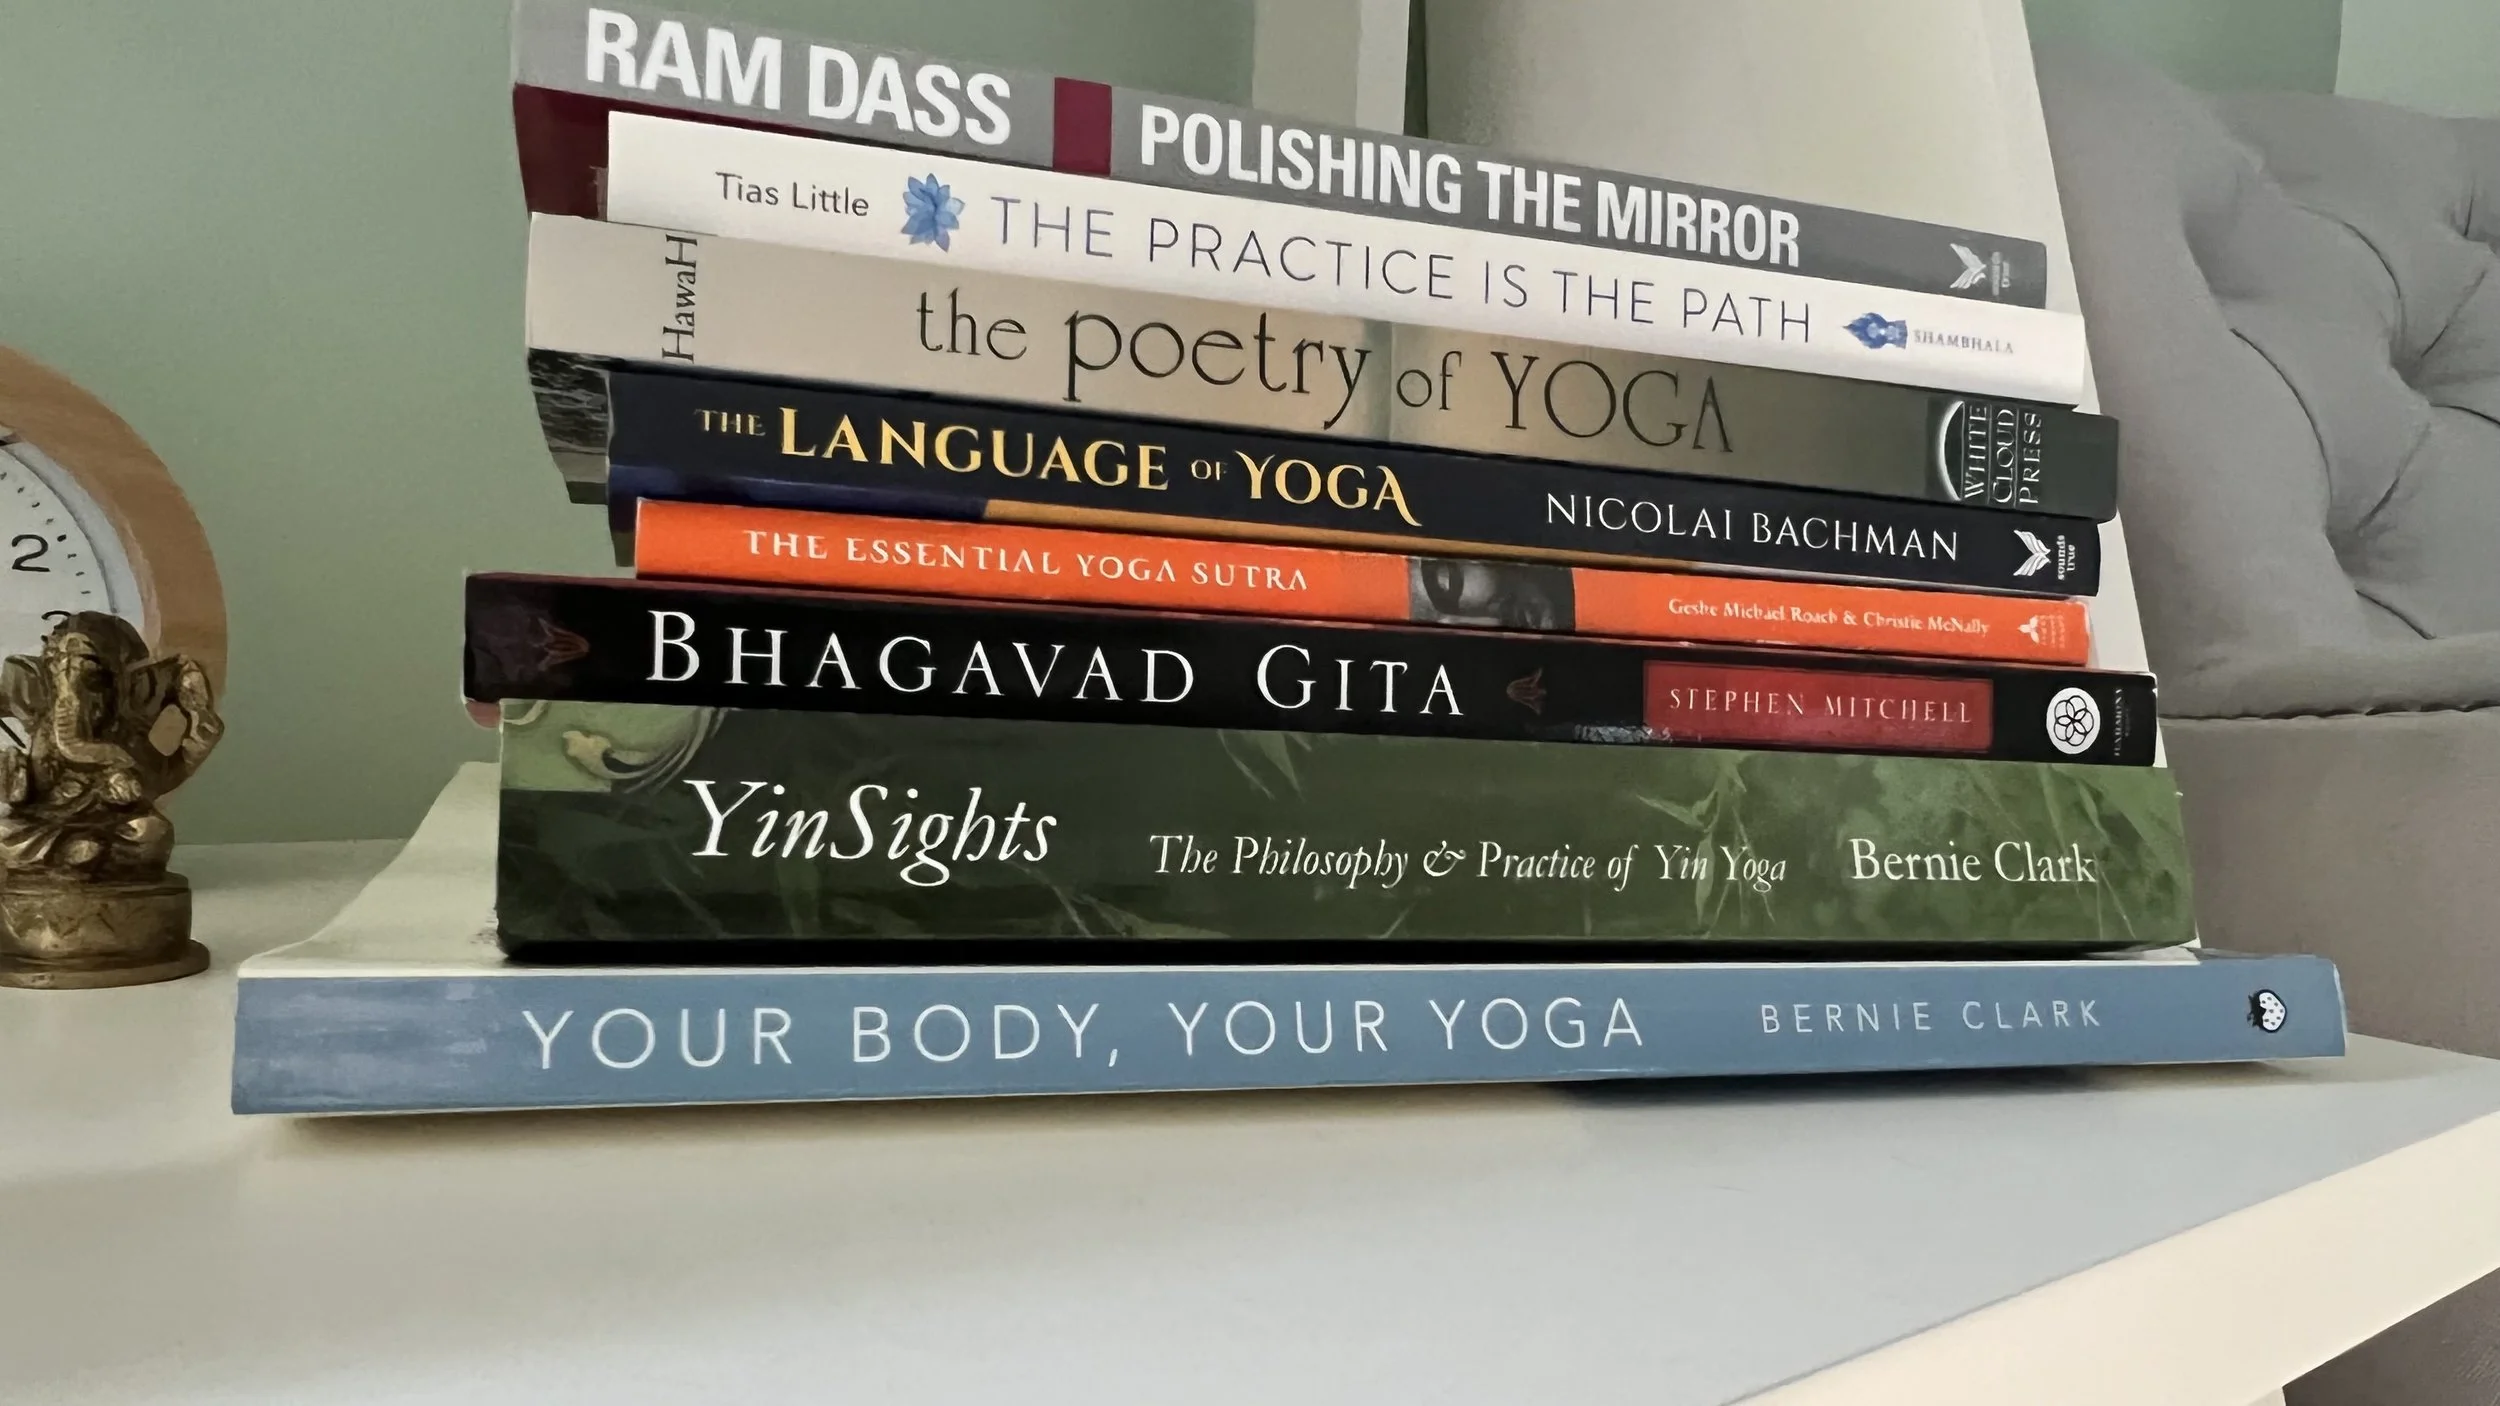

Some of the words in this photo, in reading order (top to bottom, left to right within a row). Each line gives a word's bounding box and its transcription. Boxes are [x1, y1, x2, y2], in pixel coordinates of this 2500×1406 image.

[586, 7, 783, 112] RAM
[808, 44, 1011, 146] DASS
[715, 171, 780, 206] Tias
[792, 183, 870, 217] Little
[1141, 103, 1462, 214] POLISHING
[1476, 160, 1582, 233] THE
[1597, 180, 1800, 268] MIRROR
[661, 234, 699, 363] HawaH
[991, 196, 1114, 258] THE
[1149, 217, 1454, 300] PRACTICE
[1484, 260, 1529, 309] IS
[1552, 270, 1655, 324] THE
[1683, 287, 1810, 343] PATH
[916, 287, 1028, 361] the
[1062, 310, 1372, 431] poetry
[1396, 350, 1463, 411] of
[1489, 351, 1733, 453] YOGA
[1913, 328, 2015, 355] SHAMBHALA
[694, 408, 767, 437] THE
[779, 405, 1169, 492] LANGUAGE
[1190, 458, 1228, 482] OF
[1233, 449, 1423, 528] YOGA
[1964, 404, 1989, 500] WHITE
[1994, 408, 2016, 504] CLOUD
[2018, 411, 2043, 505] PRESS
[10, 533, 52, 575] 2
[743, 529, 828, 560] THE
[846, 537, 1061, 576] ESSENTIAL
[1076, 553, 1176, 584] YOGA
[1191, 561, 1309, 592] SUTRA
[1546, 493, 1733, 541] NICOLAI
[1752, 511, 1959, 562] BACHMAN
[2056, 534, 2066, 581] sounds
[2066, 544, 2076, 572] true
[1723, 600, 1786, 624] Michael
[1790, 605, 1839, 627] Roach
[1842, 609, 1858, 627] &
[1863, 611, 1923, 632] Christie
[1927, 615, 1991, 640] McNally
[645, 609, 1195, 704] BHAGAVAD
[1256, 643, 1464, 717] GITA
[1669, 686, 1806, 717] STEPHEN
[1824, 694, 1973, 725] MITCHELL
[682, 778, 1059, 888] YinSights
[1149, 833, 1218, 876] The
[1229, 835, 1410, 891] Philosophy
[1423, 839, 1467, 879] &
[1476, 840, 1597, 881] Practice
[1606, 844, 1638, 893] of
[1654, 844, 1708, 884] Yin
[1719, 845, 1787, 894] Yoga
[1848, 837, 1984, 884] Bernie
[1993, 840, 2099, 885] Clark
[521, 1006, 794, 1071] YOUR
[851, 1001, 1121, 1068] BODY,
[1167, 1000, 1389, 1057] YOUR
[1428, 995, 1645, 1052] YOGA
[1760, 1002, 1933, 1036] BERNIE
[1961, 999, 2102, 1032] CLARK
